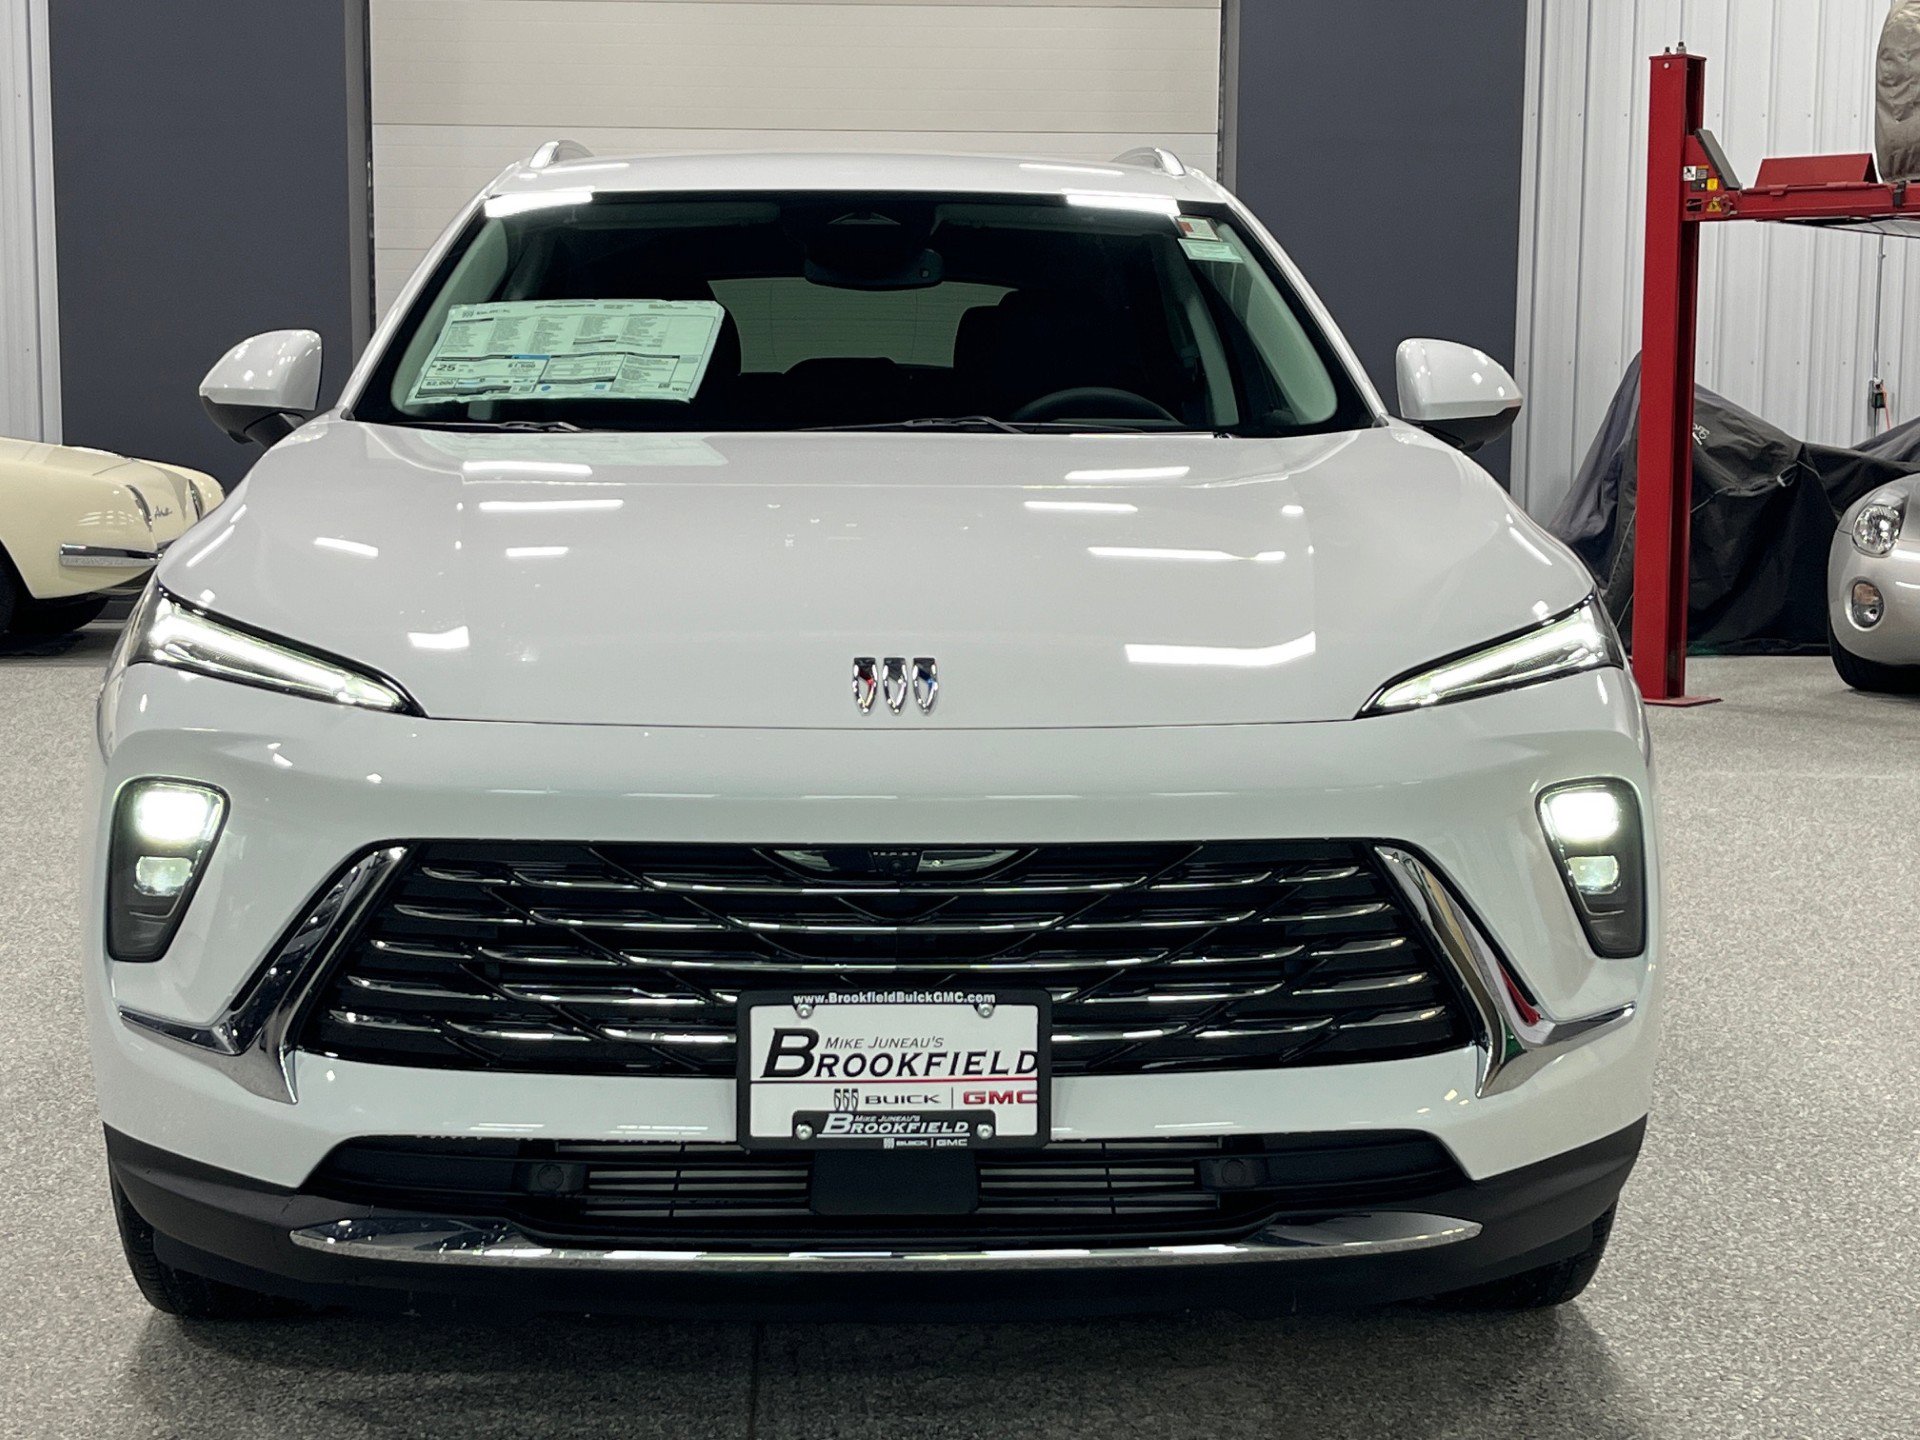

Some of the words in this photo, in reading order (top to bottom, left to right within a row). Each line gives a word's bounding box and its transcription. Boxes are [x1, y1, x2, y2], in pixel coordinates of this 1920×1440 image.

[793, 992, 996, 1005] www.BrookfieldBuickGMC.com
[760, 1027, 1038, 1079] BROOKFIELD
[865, 1094, 942, 1105] BUICK
[963, 1090, 1038, 1105] GMC
[822, 1112, 969, 1134] BROOKFIELD
[936, 1138, 968, 1146] GMC
